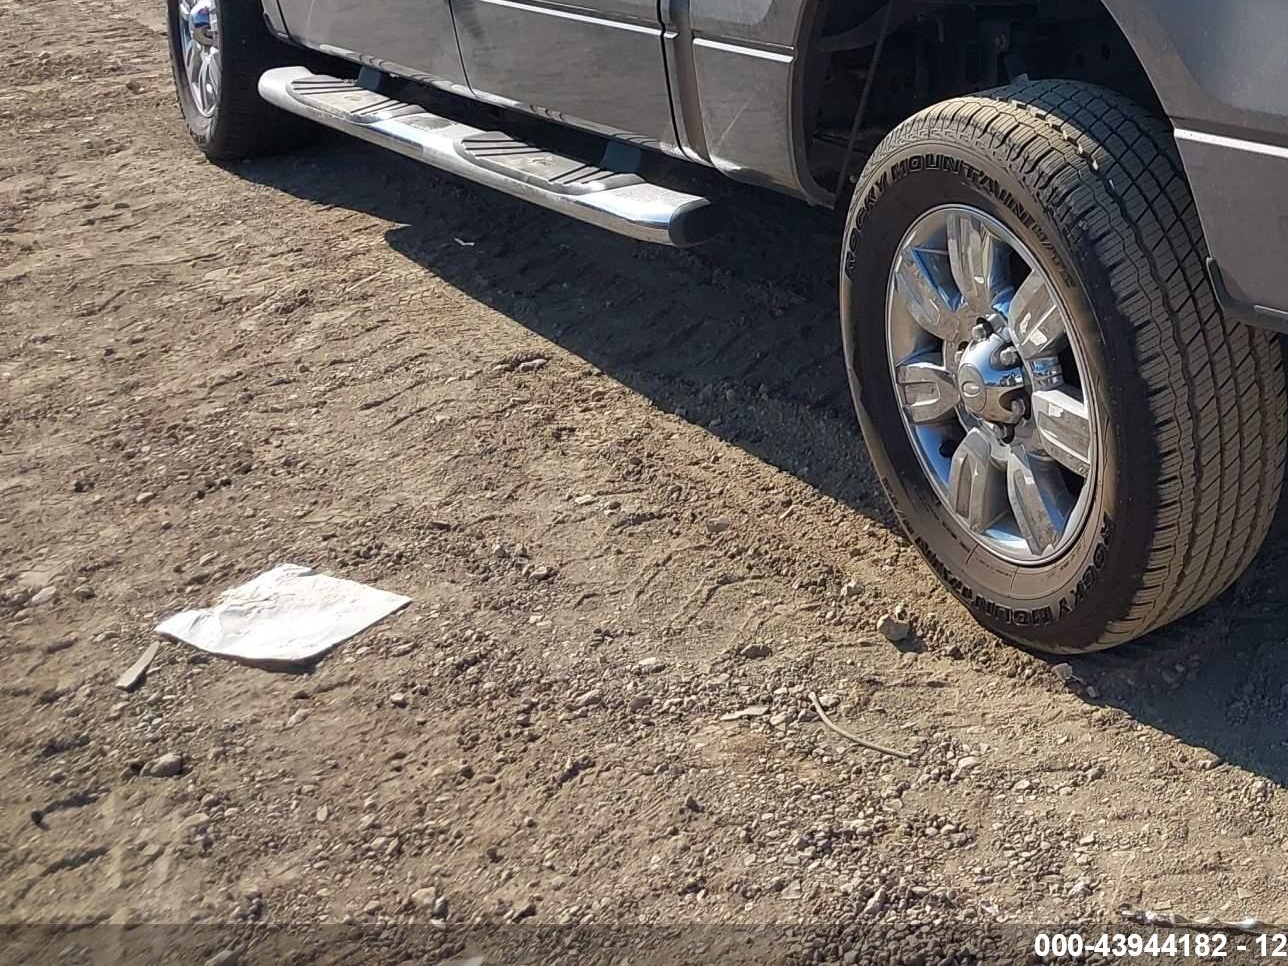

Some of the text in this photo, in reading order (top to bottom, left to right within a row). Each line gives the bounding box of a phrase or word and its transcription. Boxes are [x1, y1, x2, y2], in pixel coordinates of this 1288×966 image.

[845, 171, 888, 282] ROCKY
[890, 153, 1036, 230] MOUNTAIN
[914, 511, 1114, 627] ROCKY MOUNTAIN
